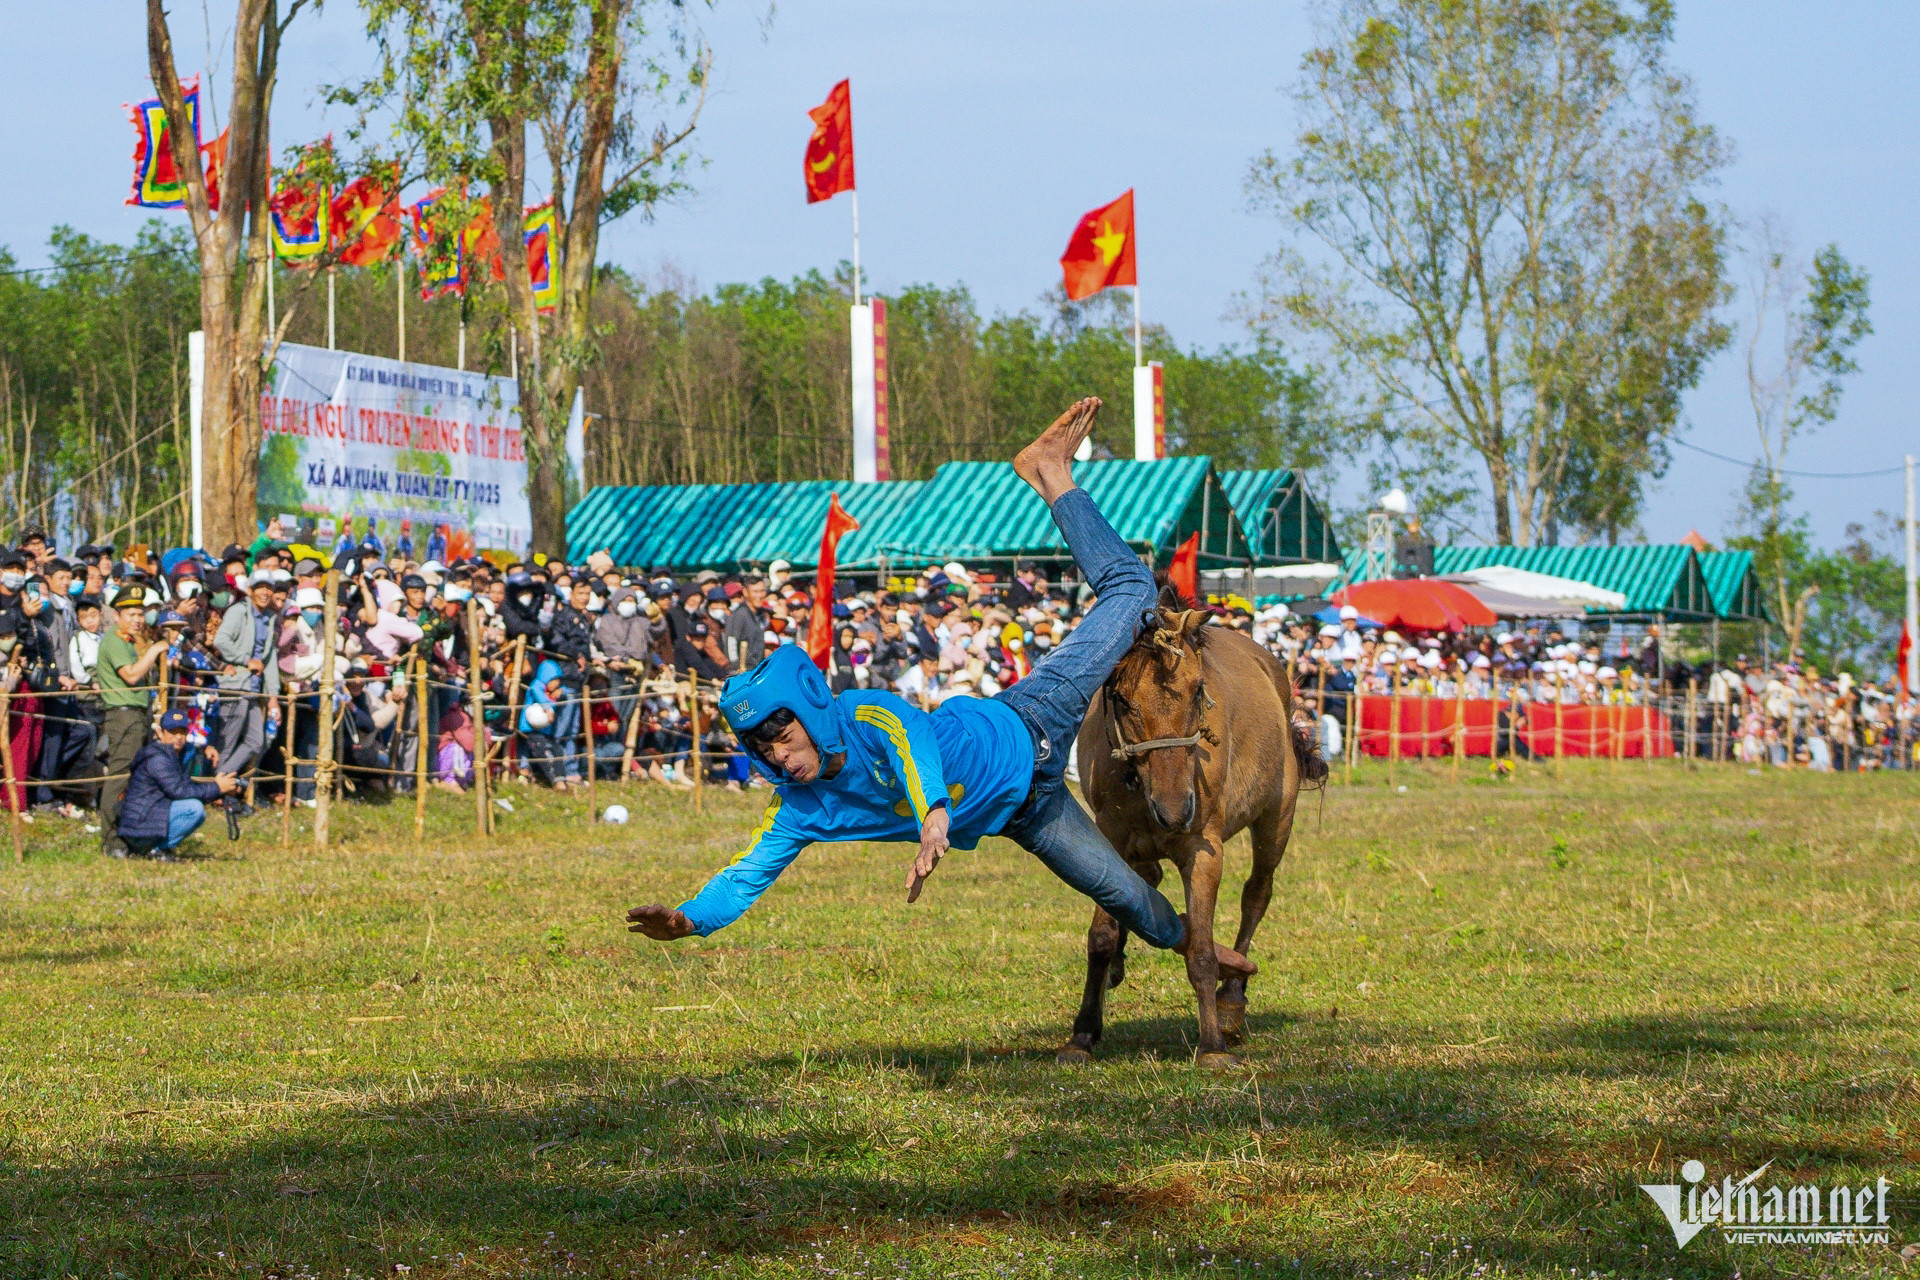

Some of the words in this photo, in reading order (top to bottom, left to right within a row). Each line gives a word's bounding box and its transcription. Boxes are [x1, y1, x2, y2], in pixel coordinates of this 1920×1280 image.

[260, 381, 277, 441] ỘI
[332, 464, 351, 488] AN
[395, 469, 429, 497] XUÂN
